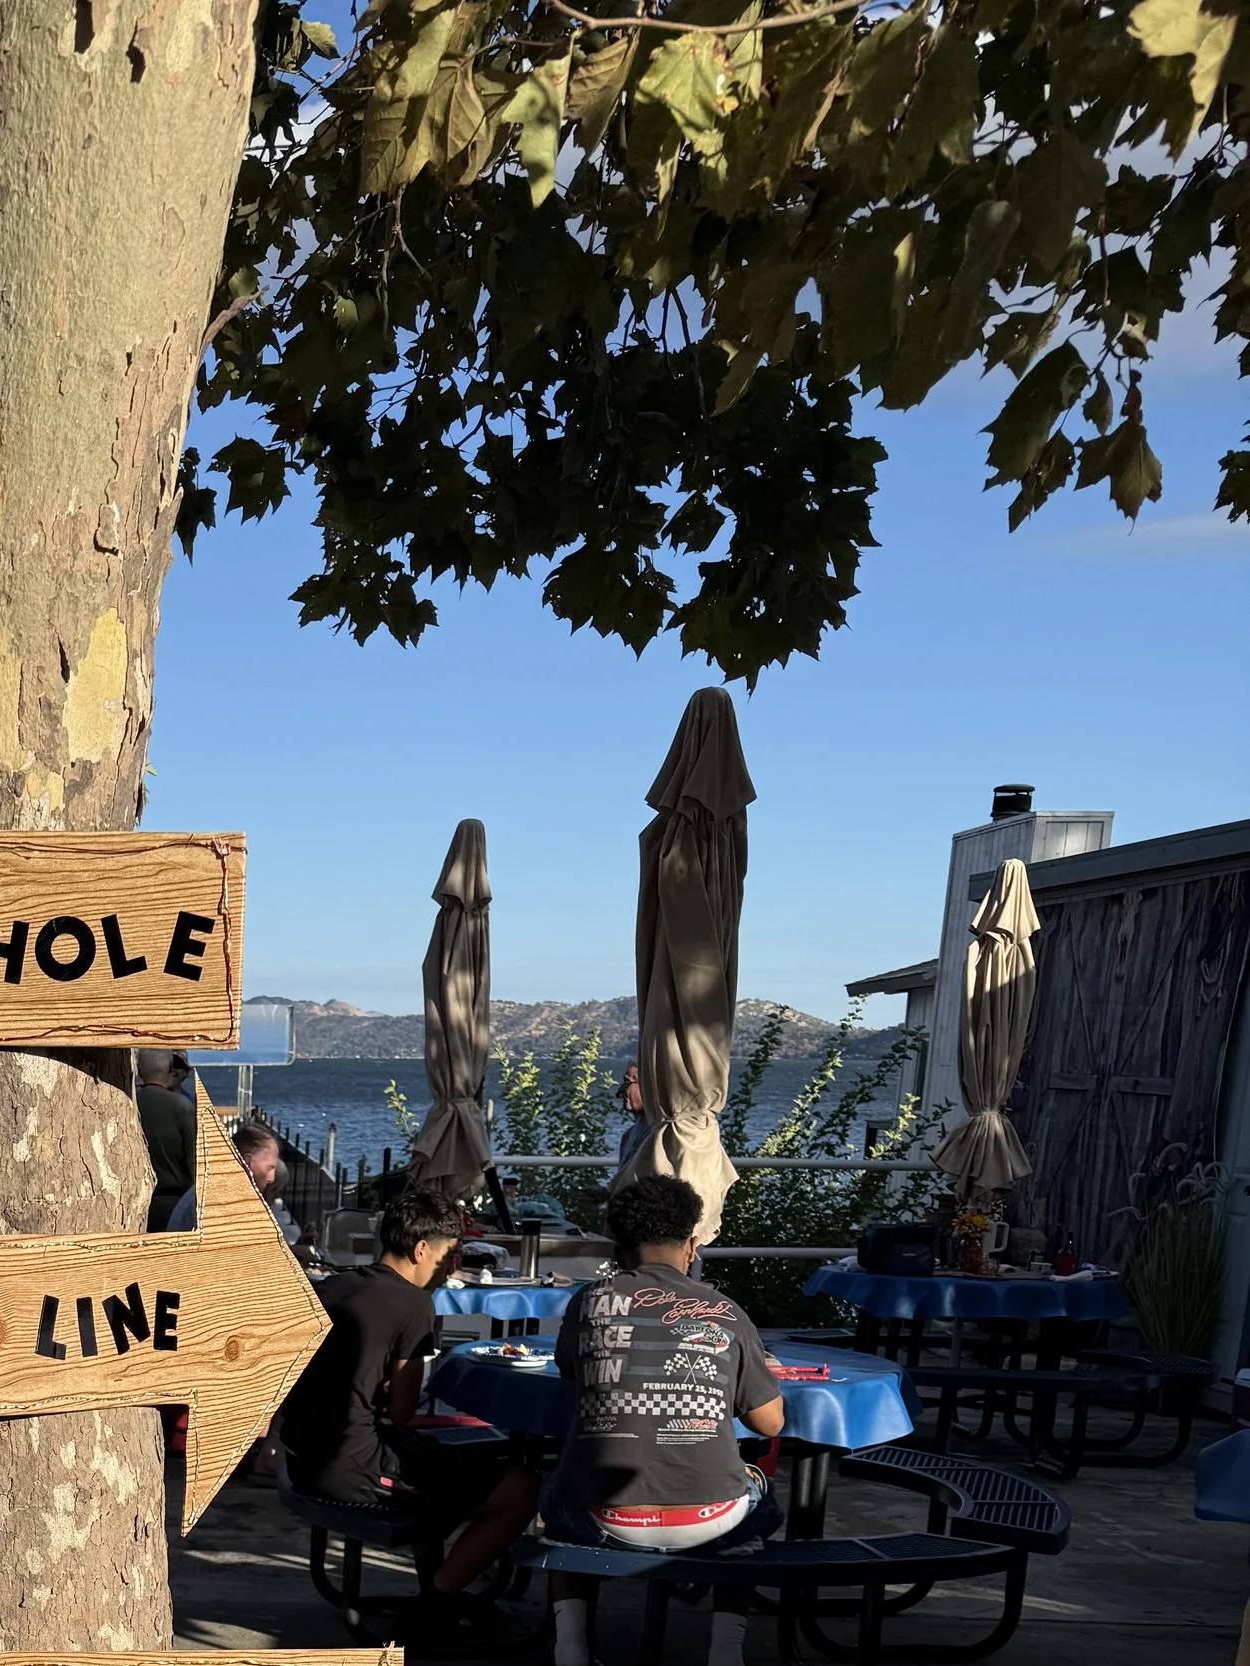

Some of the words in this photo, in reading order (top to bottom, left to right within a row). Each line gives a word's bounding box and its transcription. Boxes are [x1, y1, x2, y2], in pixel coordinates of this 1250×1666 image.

[35, 1281, 181, 1360] LINE
[579, 1294, 632, 1322] MAN
[578, 1325, 634, 1356] RACE
[584, 1358, 622, 1387] WIN
[642, 1382, 694, 1392] FEBRUARY
